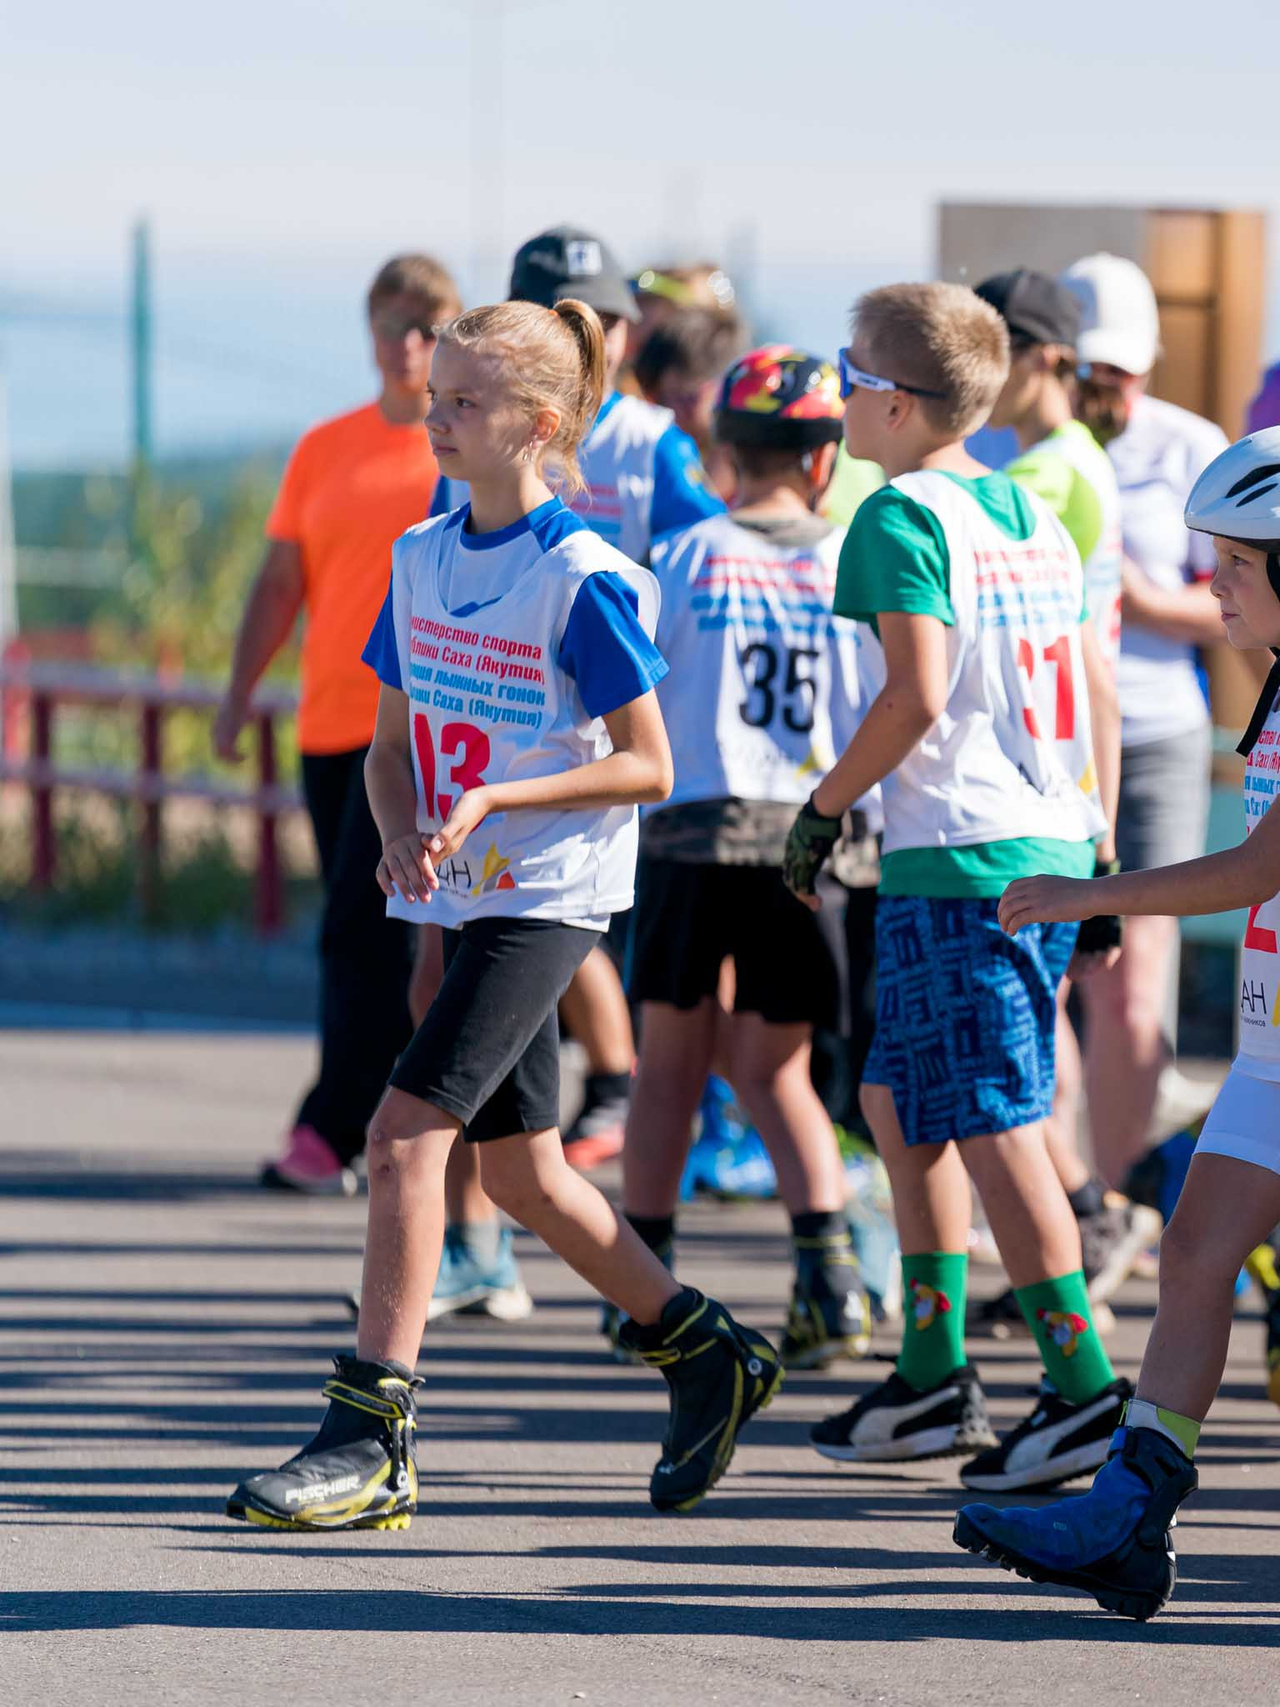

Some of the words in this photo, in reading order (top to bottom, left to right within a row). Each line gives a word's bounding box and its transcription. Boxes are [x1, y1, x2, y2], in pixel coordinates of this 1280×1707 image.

[442, 646, 473, 669] Саха
[482, 633, 543, 660] спорта
[739, 643, 819, 733] 35
[433, 689, 464, 713] Саха
[468, 698, 543, 730] (Якутия)
